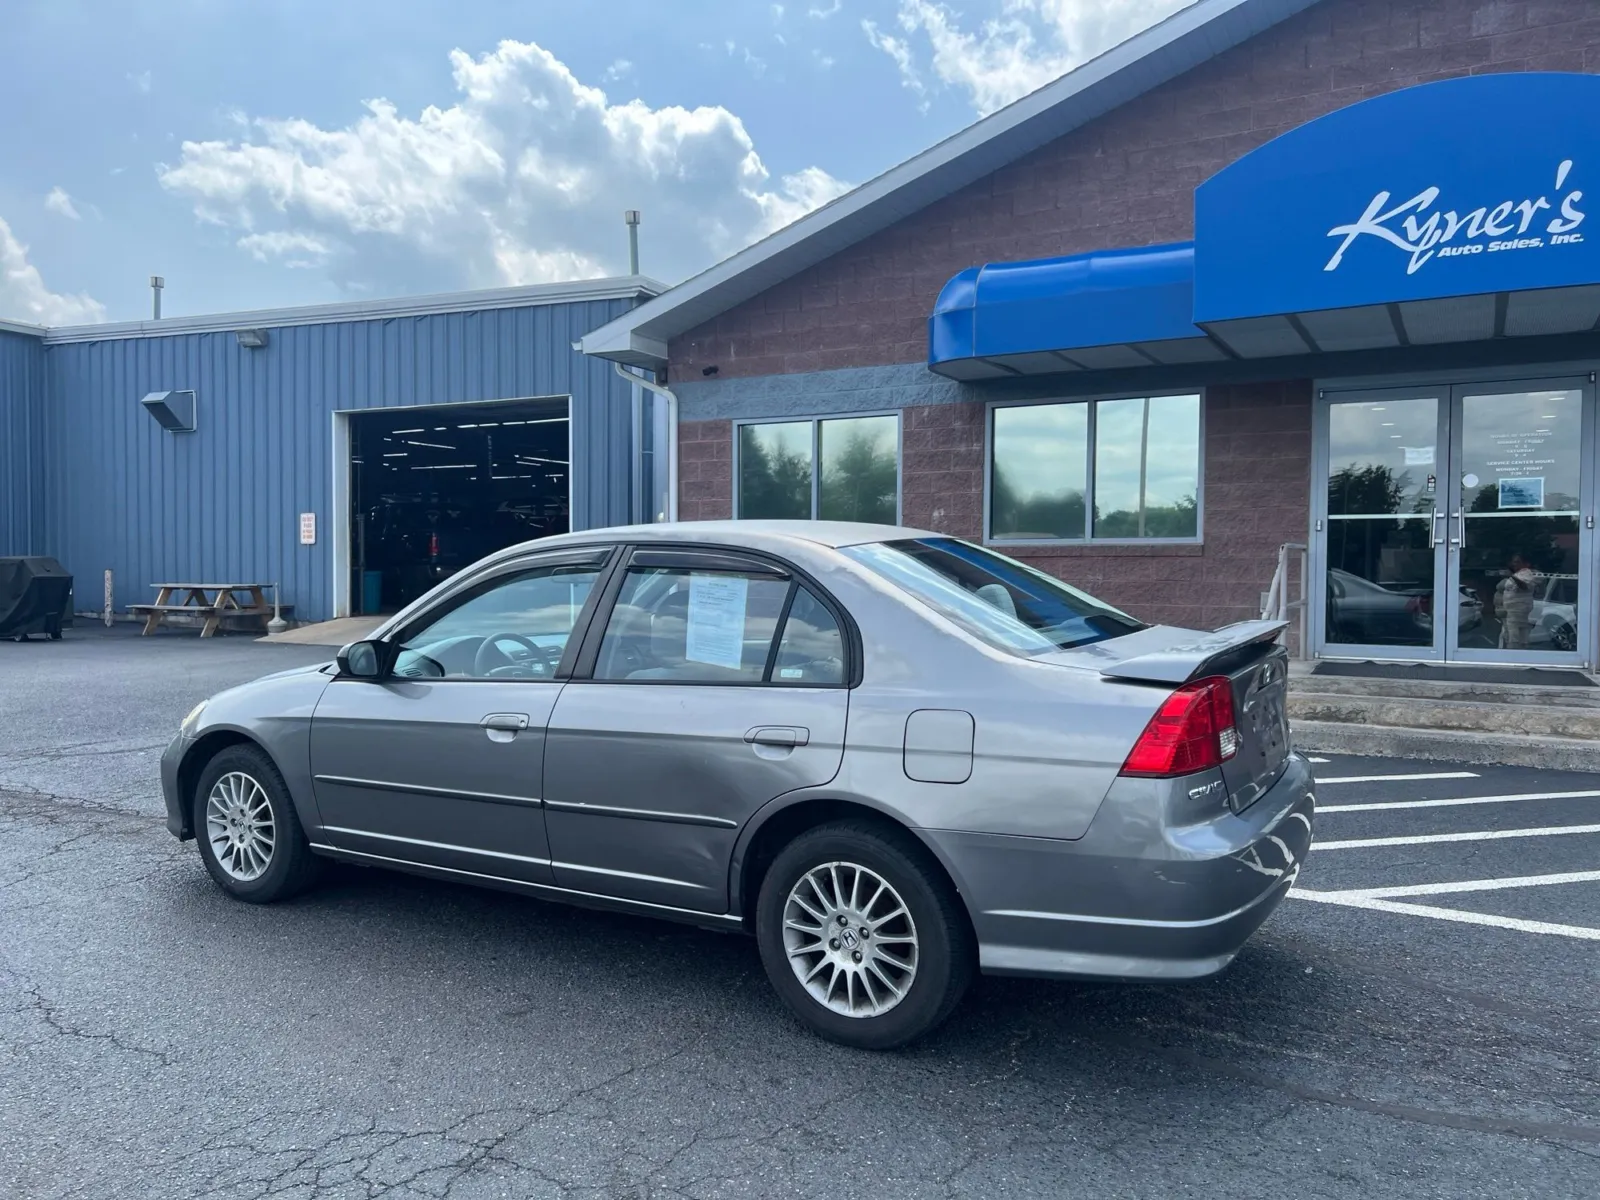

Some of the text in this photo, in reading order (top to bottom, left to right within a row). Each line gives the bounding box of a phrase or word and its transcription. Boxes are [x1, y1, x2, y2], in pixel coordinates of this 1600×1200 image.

[1324, 160, 1585, 275] Kyner's
[1437, 233, 1584, 258] Auto Sales, Inc.
